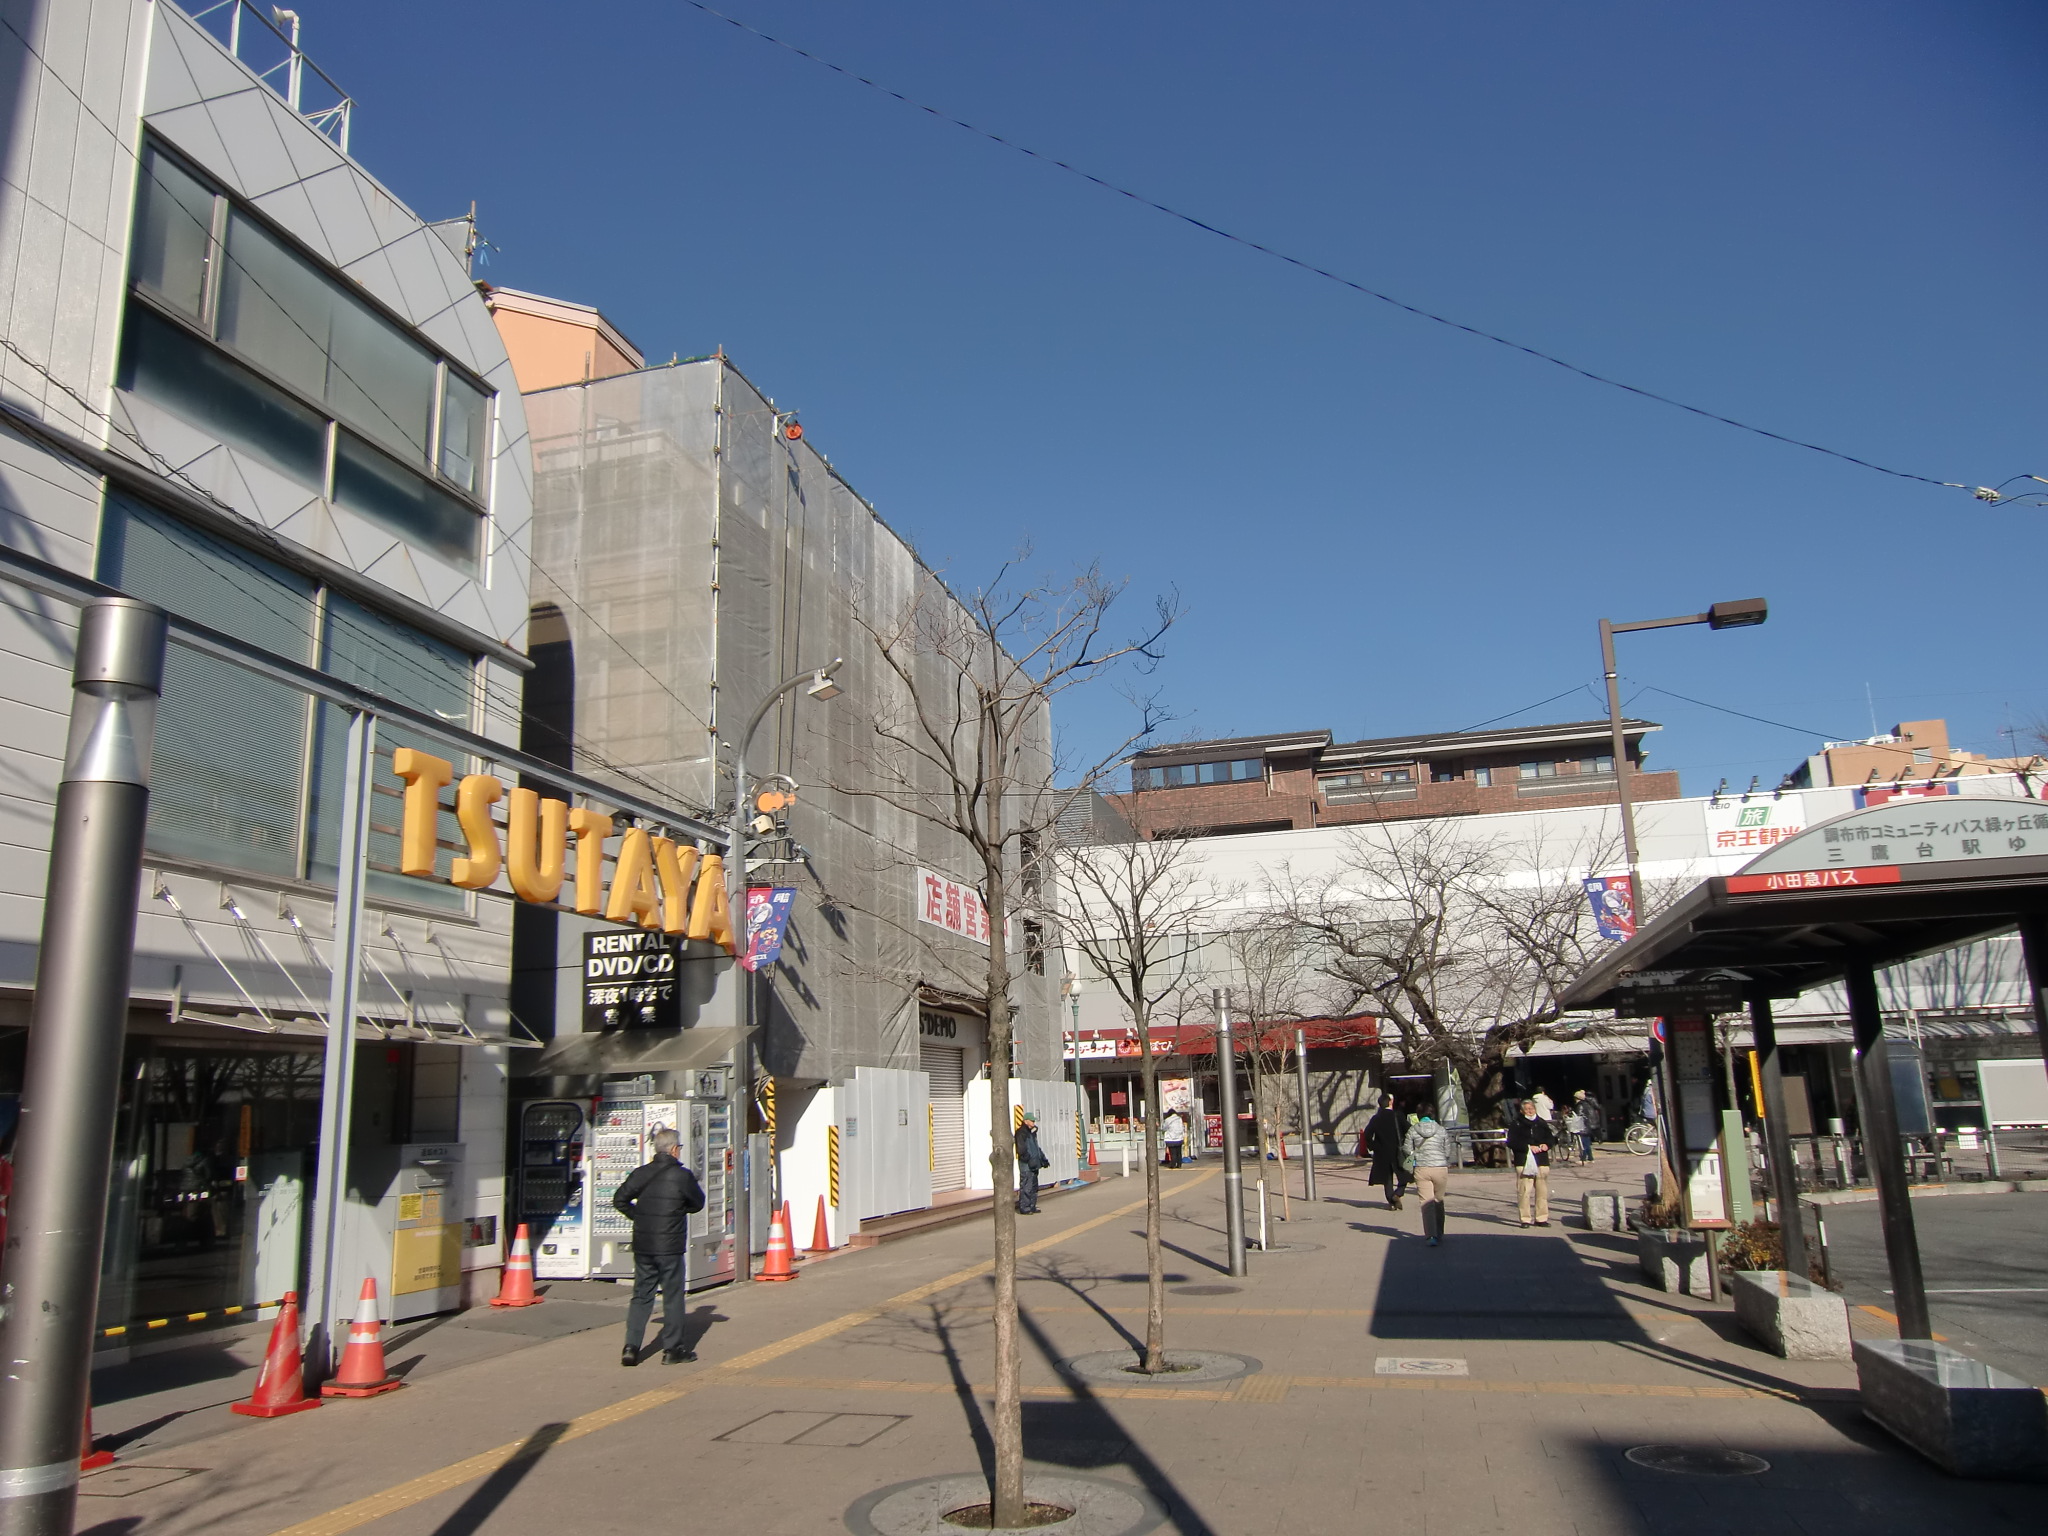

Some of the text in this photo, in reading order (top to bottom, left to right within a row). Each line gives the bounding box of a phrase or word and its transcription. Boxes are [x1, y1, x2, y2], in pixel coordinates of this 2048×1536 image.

[1740, 808, 1766, 825] 旅
[393, 747, 735, 955] TSUTAYA
[1767, 870, 1858, 889] 小田急バス
[592, 933, 671, 954] RENTAL
[587, 953, 675, 977] DVD/CD
[588, 984, 674, 1006] 深夜1時まで
[604, 1006, 657, 1025] 営業
